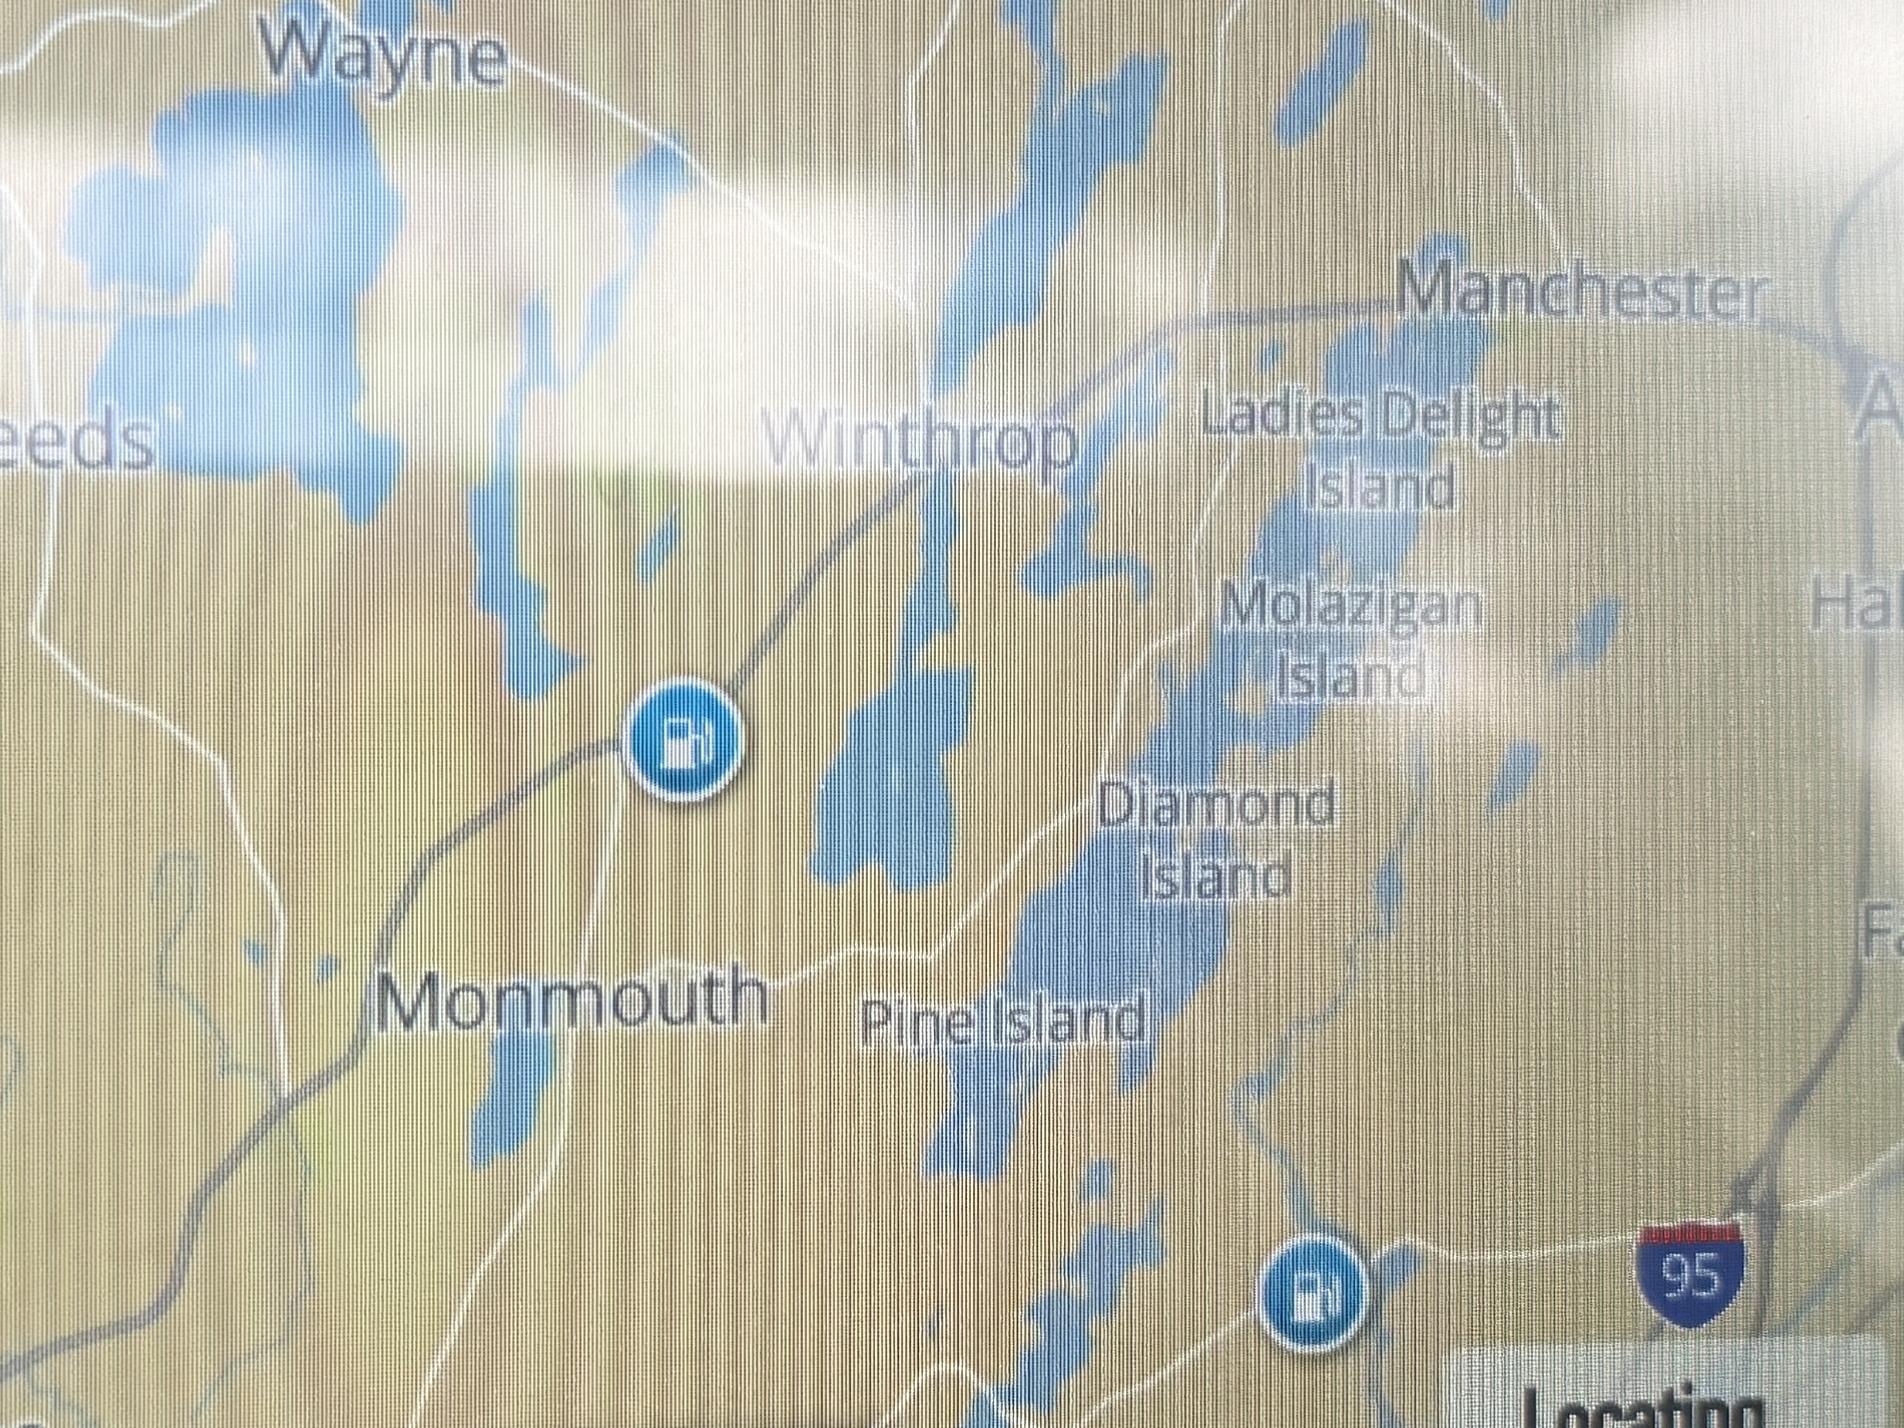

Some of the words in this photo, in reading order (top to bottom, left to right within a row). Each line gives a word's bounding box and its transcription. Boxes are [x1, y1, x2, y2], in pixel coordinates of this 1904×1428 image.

[256, 14, 509, 103] Wayne
[1399, 260, 1770, 322] Manchester
[759, 405, 1080, 485] Winthrop
[1202, 388, 1362, 439] Ladies
[1380, 388, 1563, 453] Delight
[1304, 461, 1457, 510] Island
[1223, 581, 1483, 641] Molazigan
[1280, 650, 1428, 699] Island
[1099, 778, 1337, 828] Diamond
[1142, 848, 1293, 901] Island
[377, 962, 769, 1032] Monmouth
[863, 998, 974, 1047] Pine
[995, 991, 1146, 1043] Island
[1661, 1250, 1722, 1302] 95
